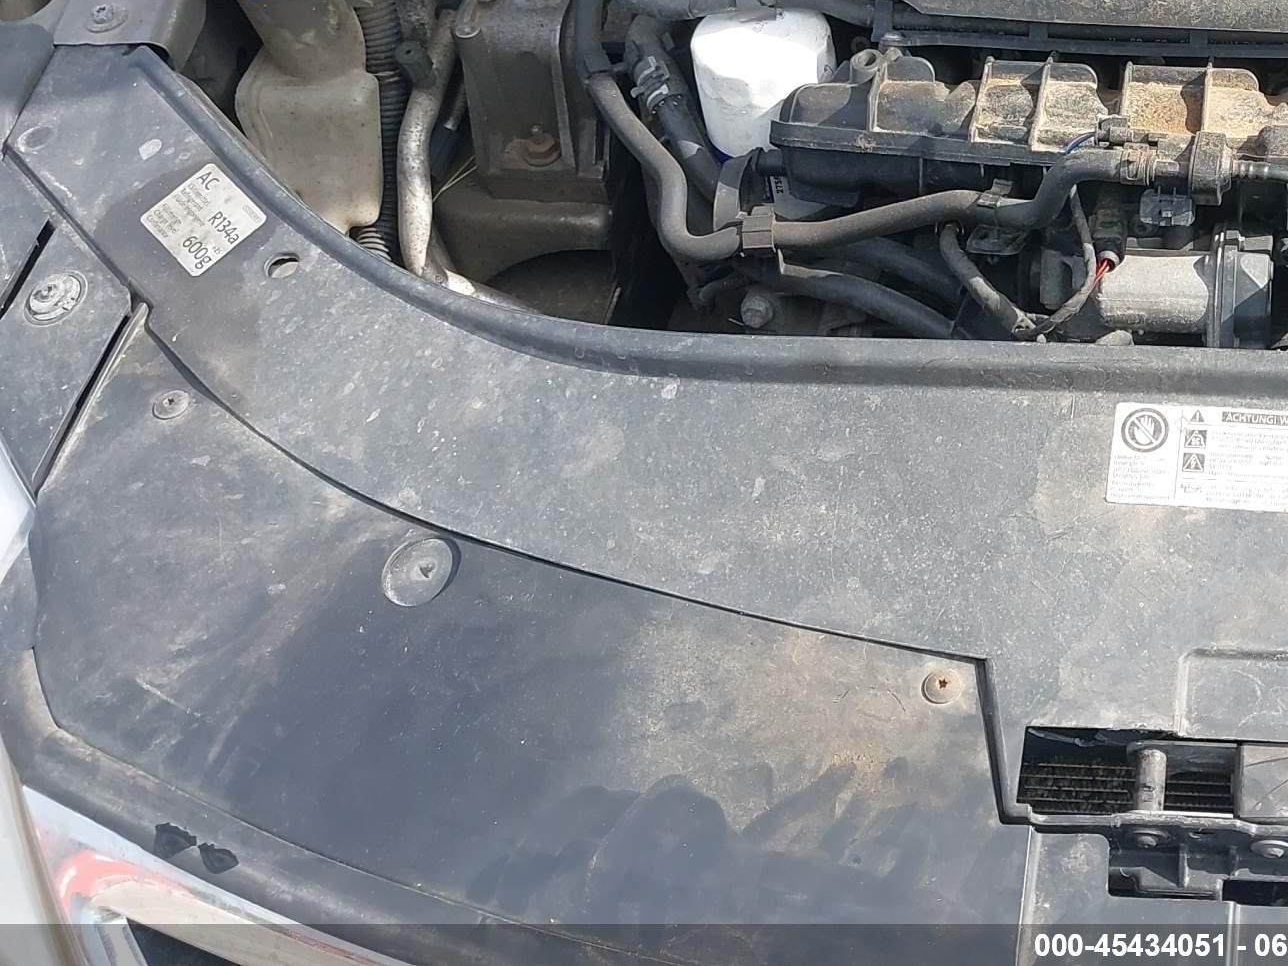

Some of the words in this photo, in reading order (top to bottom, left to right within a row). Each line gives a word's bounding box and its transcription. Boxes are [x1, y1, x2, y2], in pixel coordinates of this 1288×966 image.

[196, 171, 220, 191] AC
[208, 211, 240, 245] R134a
[182, 236, 212, 270] 600g
